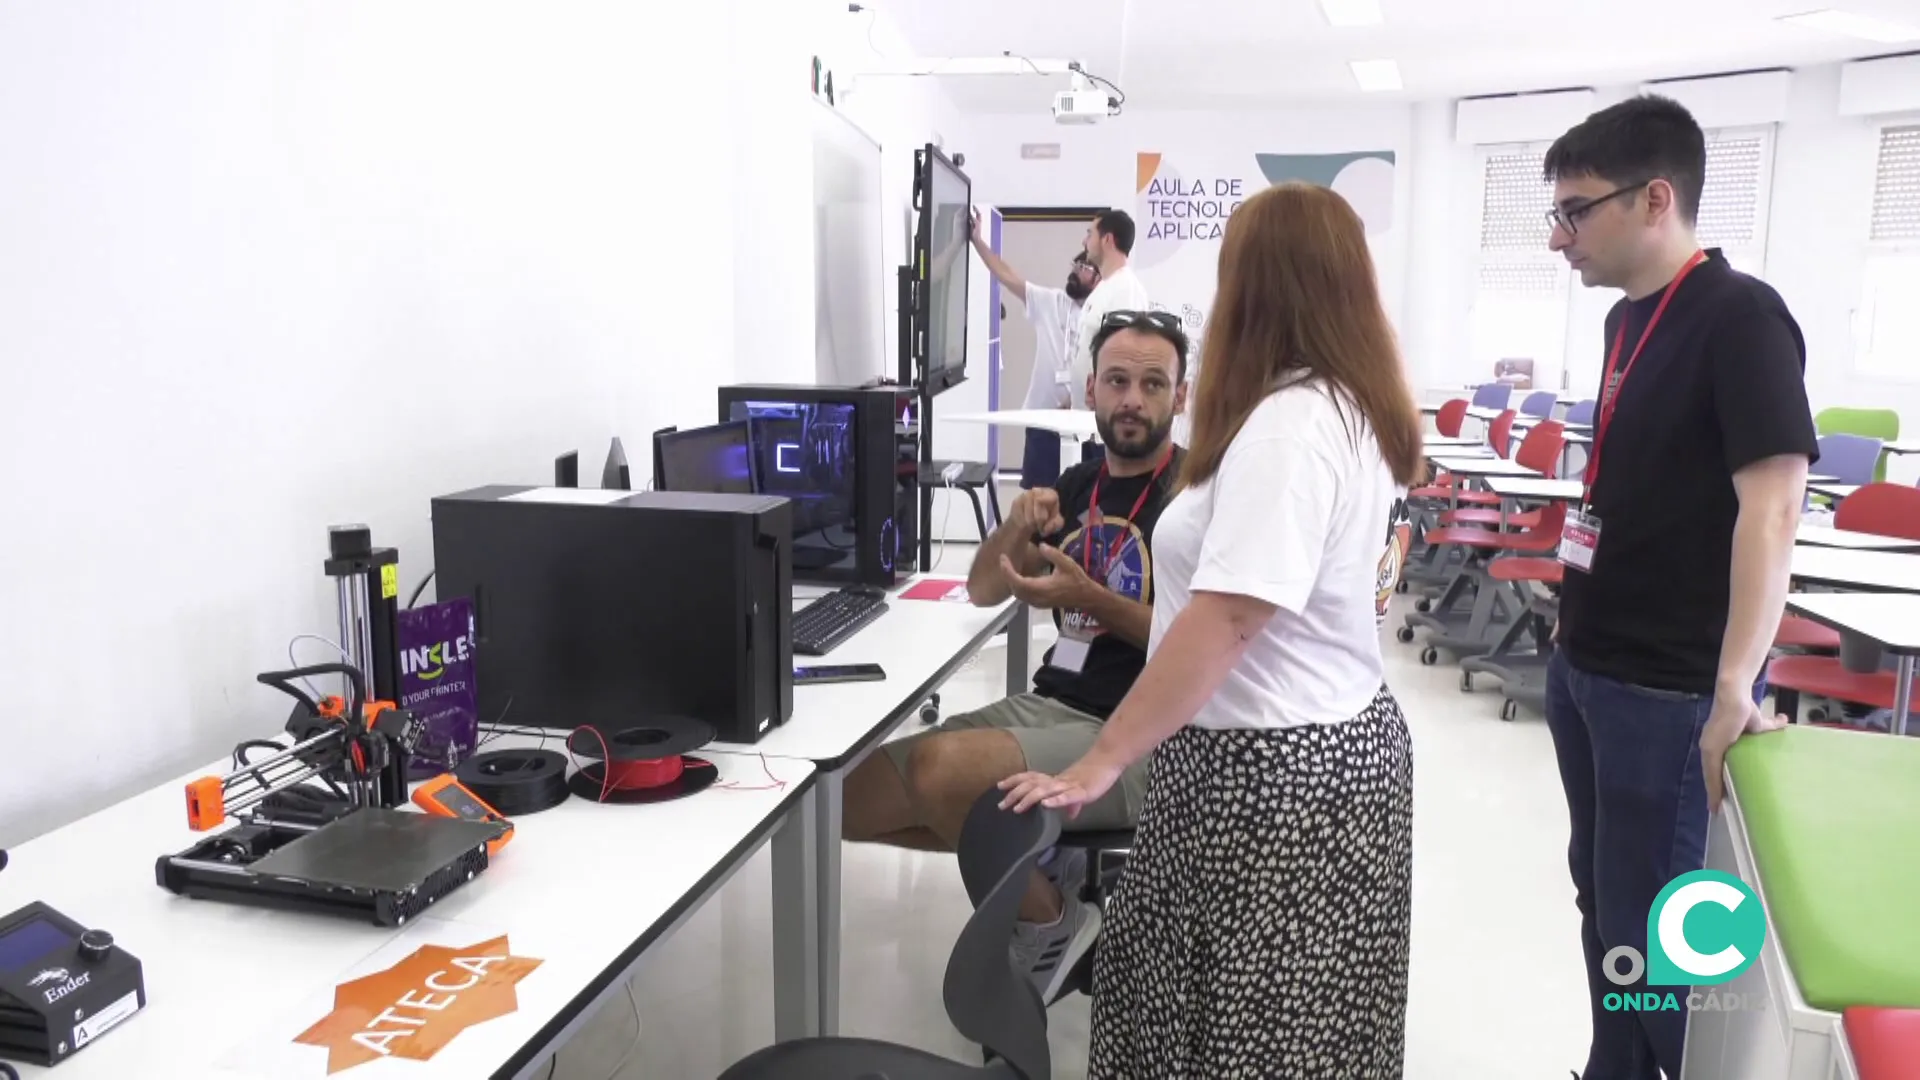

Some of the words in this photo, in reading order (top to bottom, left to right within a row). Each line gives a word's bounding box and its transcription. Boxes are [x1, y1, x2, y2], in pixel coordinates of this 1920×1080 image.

[1149, 178, 1206, 196] AULA
[1215, 178, 1243, 196] DE
[1147, 221, 1224, 240] APLICA
[408, 688, 431, 703] YOUR
[44, 971, 91, 1004] Ender
[351, 955, 507, 1055] ATECA
